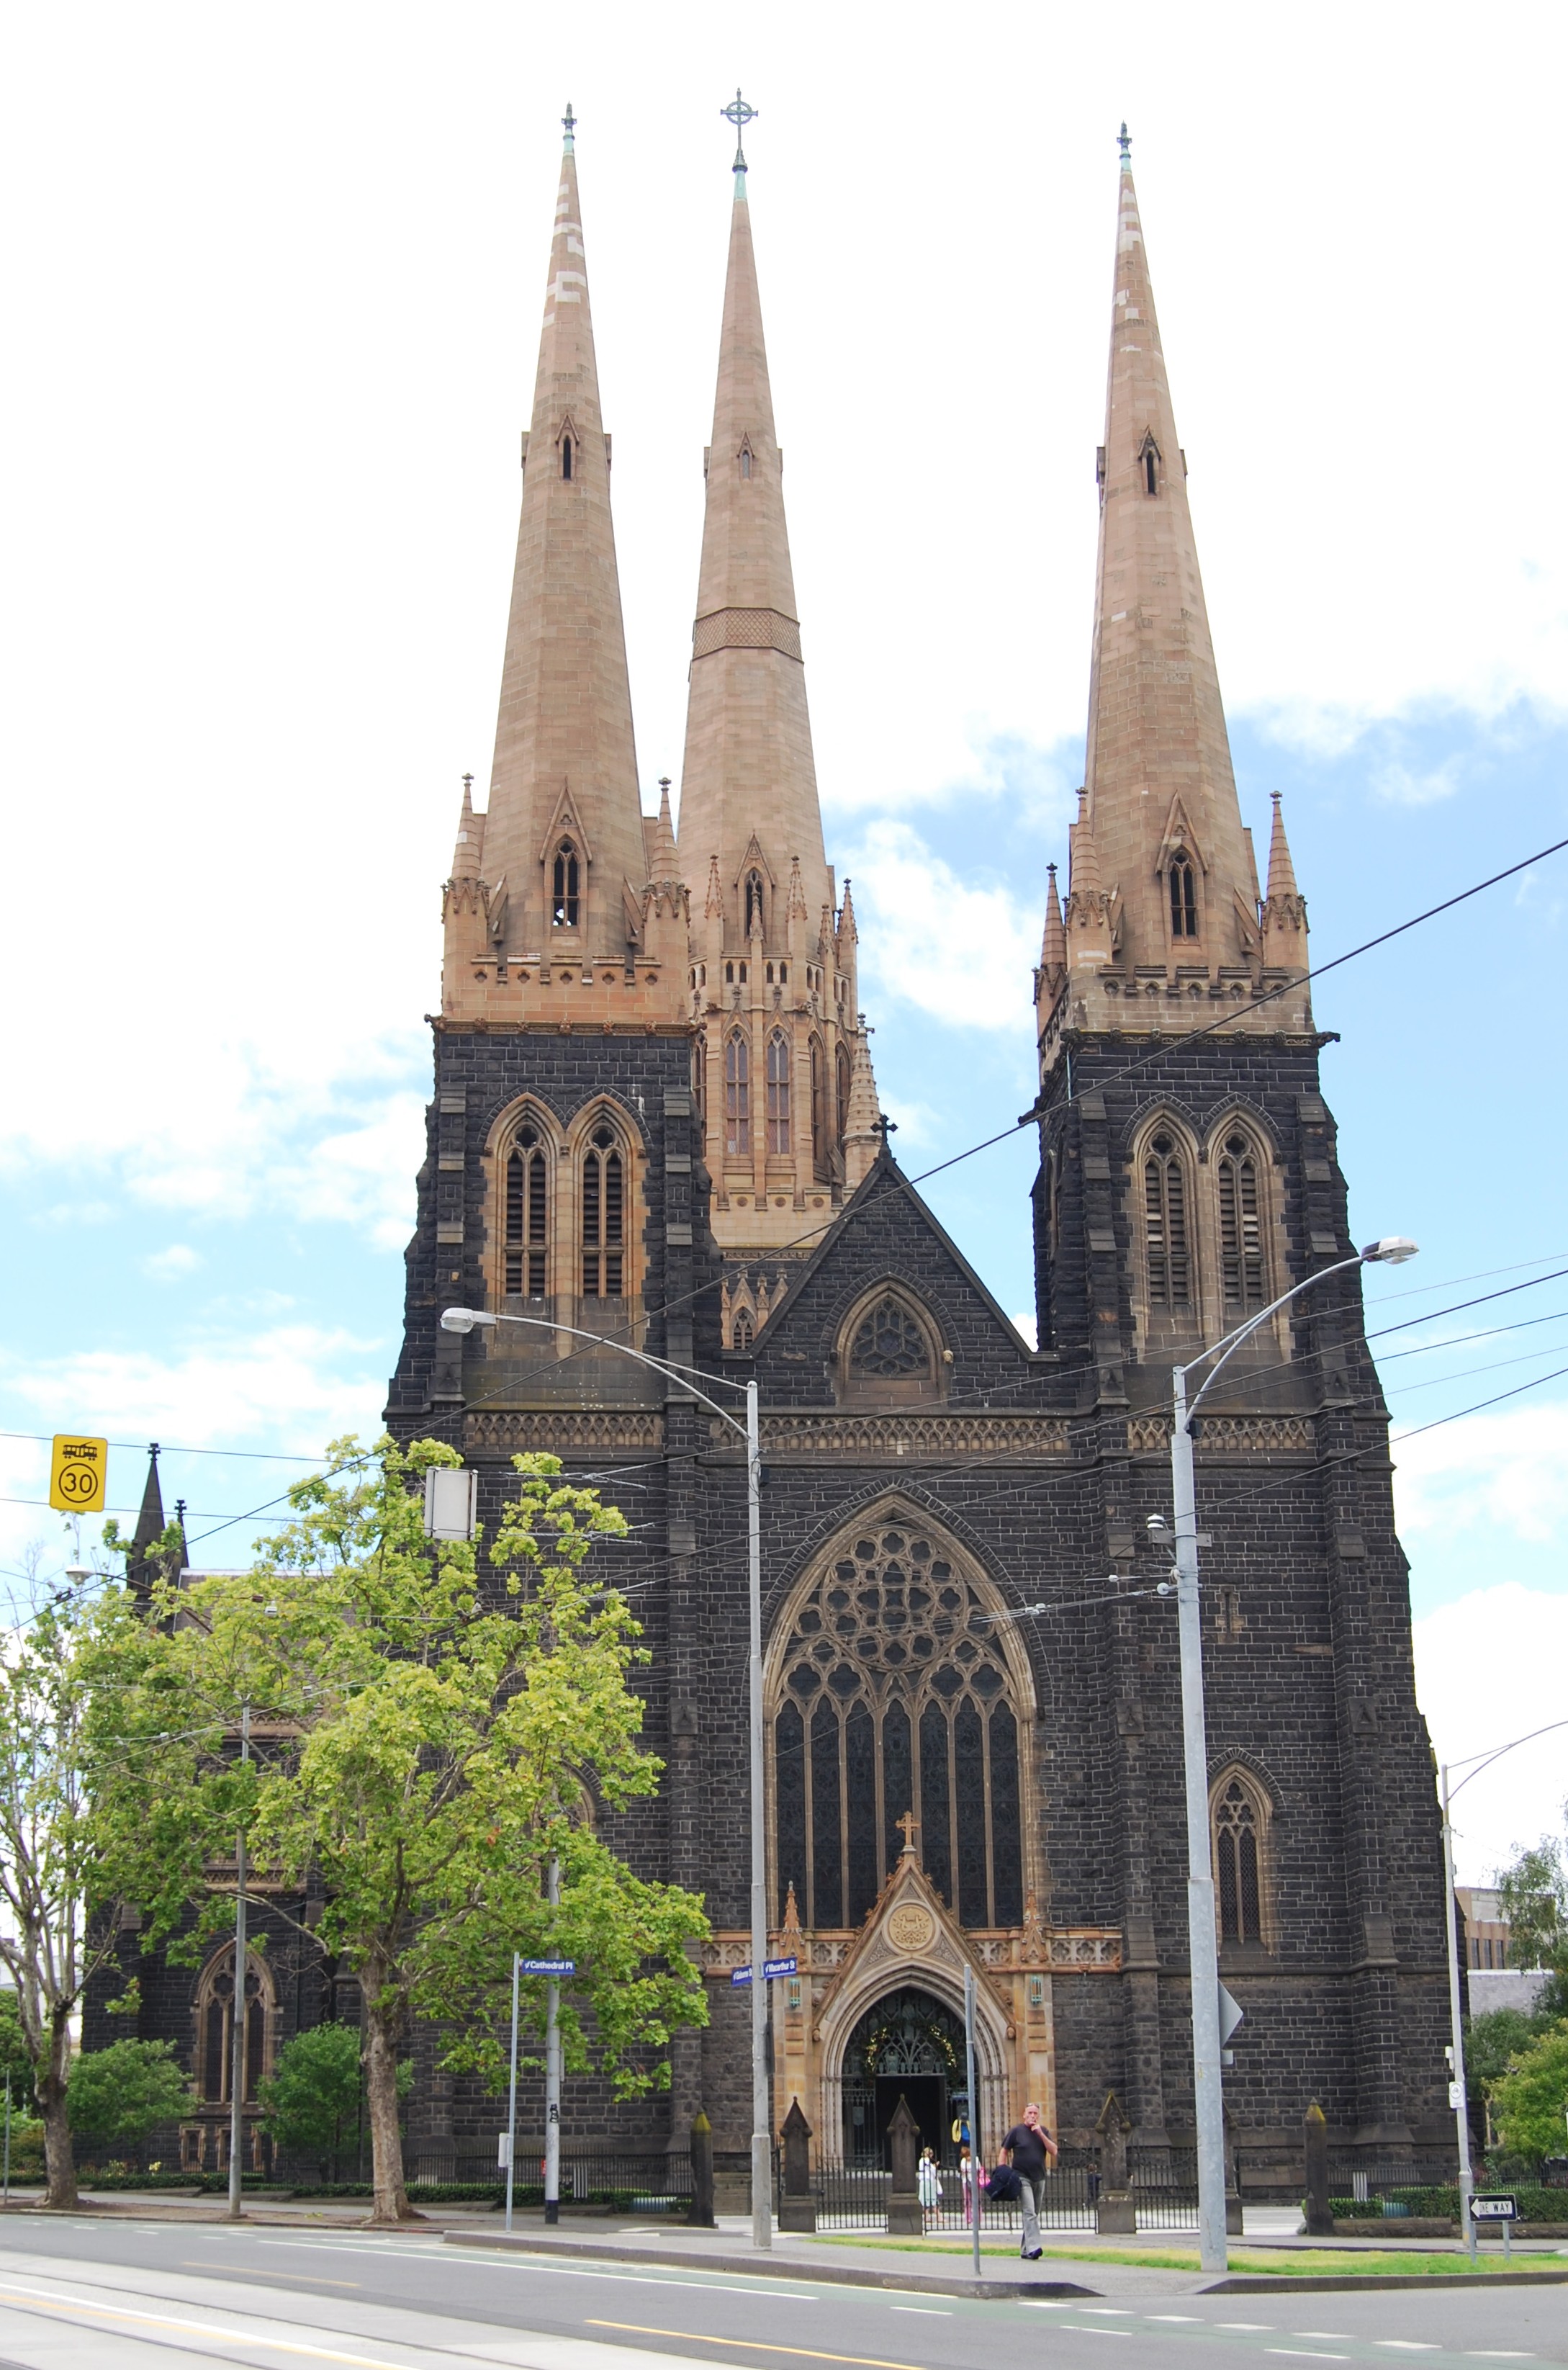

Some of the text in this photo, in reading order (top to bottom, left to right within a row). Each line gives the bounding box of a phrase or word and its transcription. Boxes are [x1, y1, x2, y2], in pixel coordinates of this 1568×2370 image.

[64, 1472, 92, 1494] 30
[531, 1961, 564, 1970] Cathedral
[1479, 2202, 1509, 2213] ONE WAY
